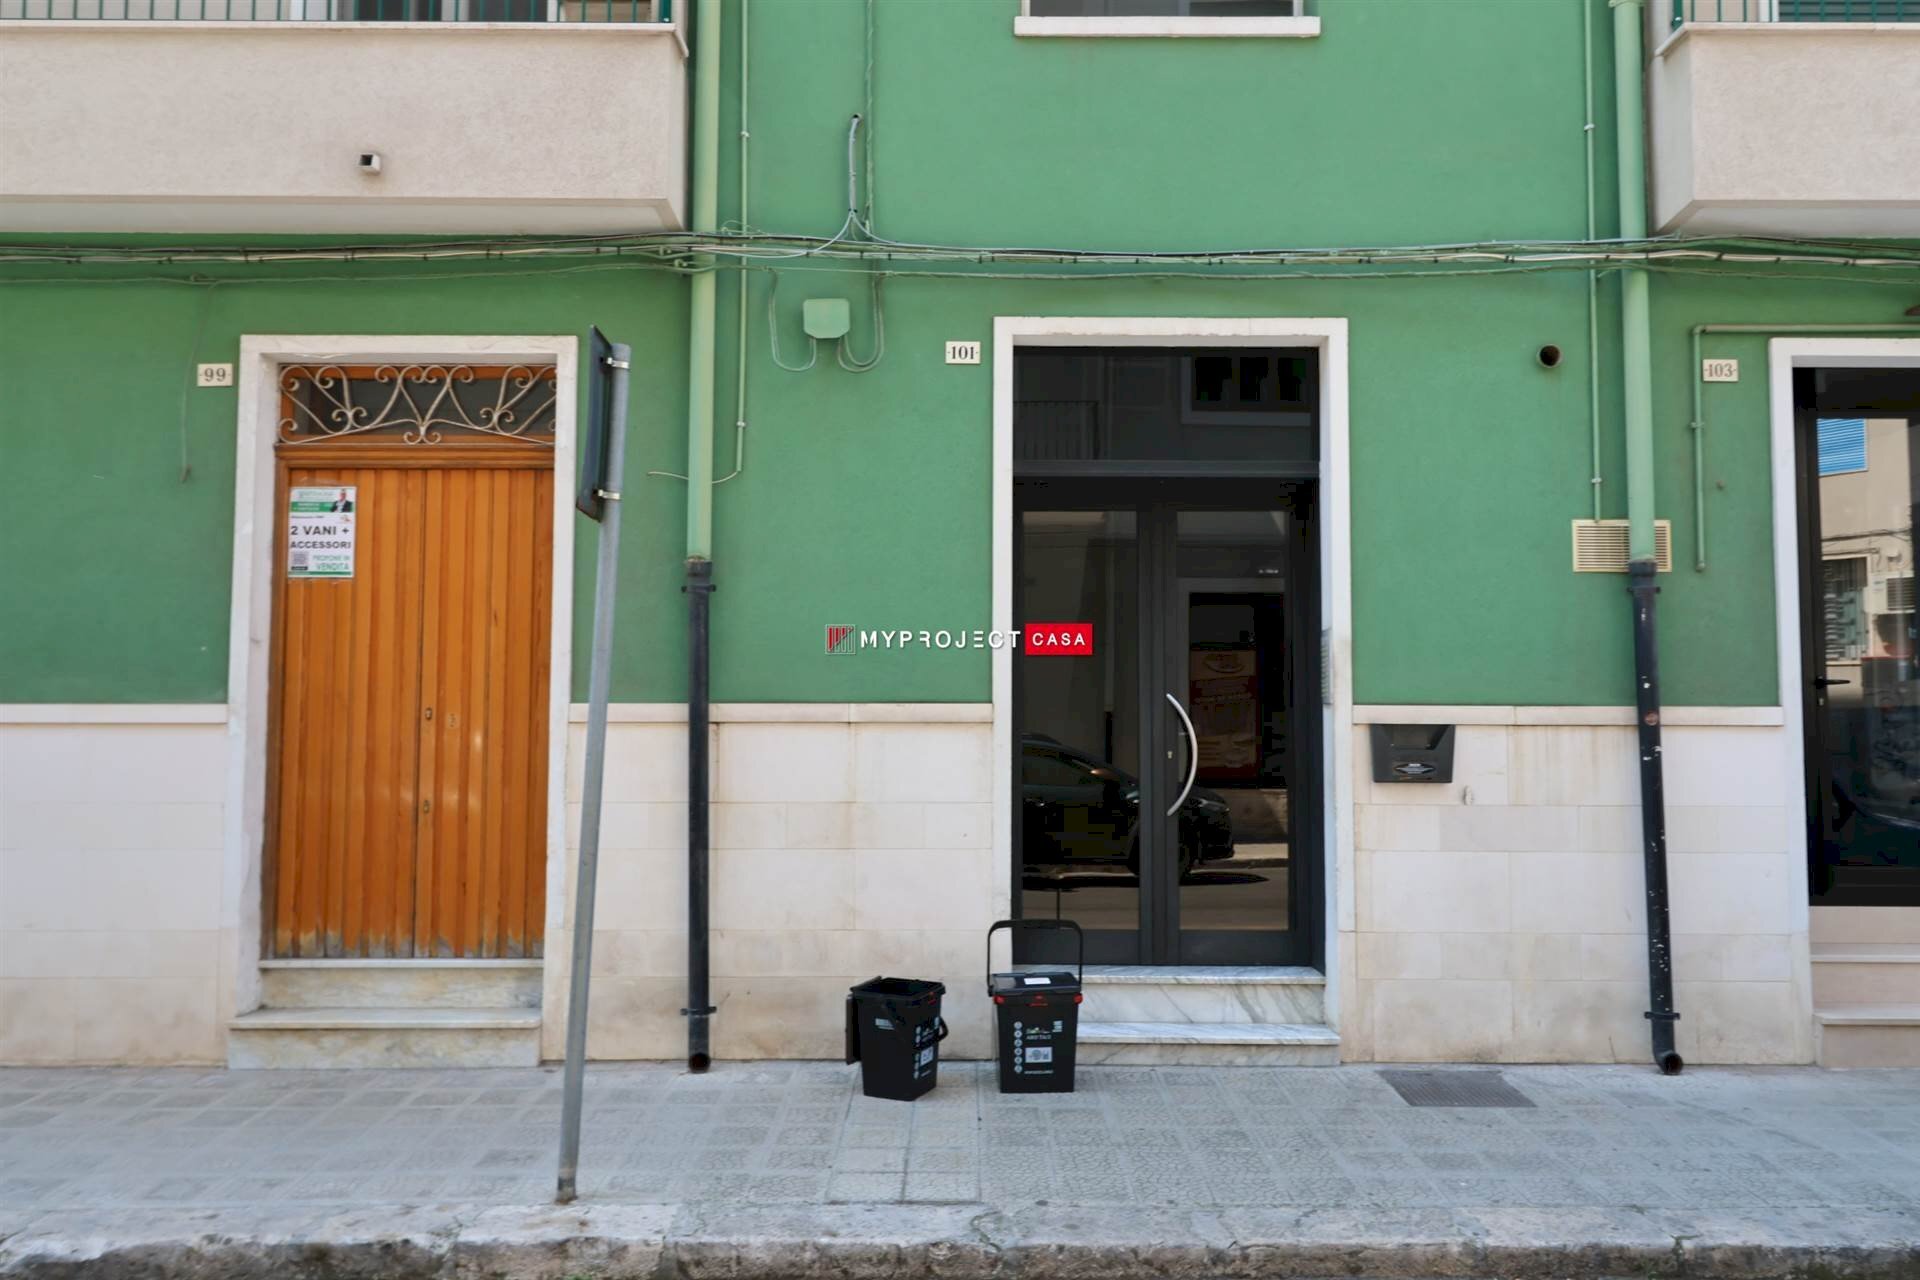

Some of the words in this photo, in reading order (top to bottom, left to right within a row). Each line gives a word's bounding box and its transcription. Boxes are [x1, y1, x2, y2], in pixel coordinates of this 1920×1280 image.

[951, 345, 974, 360] 101
[204, 367, 227, 382] 99
[1708, 363, 1733, 377] 103
[290, 525, 299, 536] 2
[303, 526, 337, 536] VANI
[290, 541, 351, 549] ACCESSORI
[317, 562, 350, 570] VENDITA
